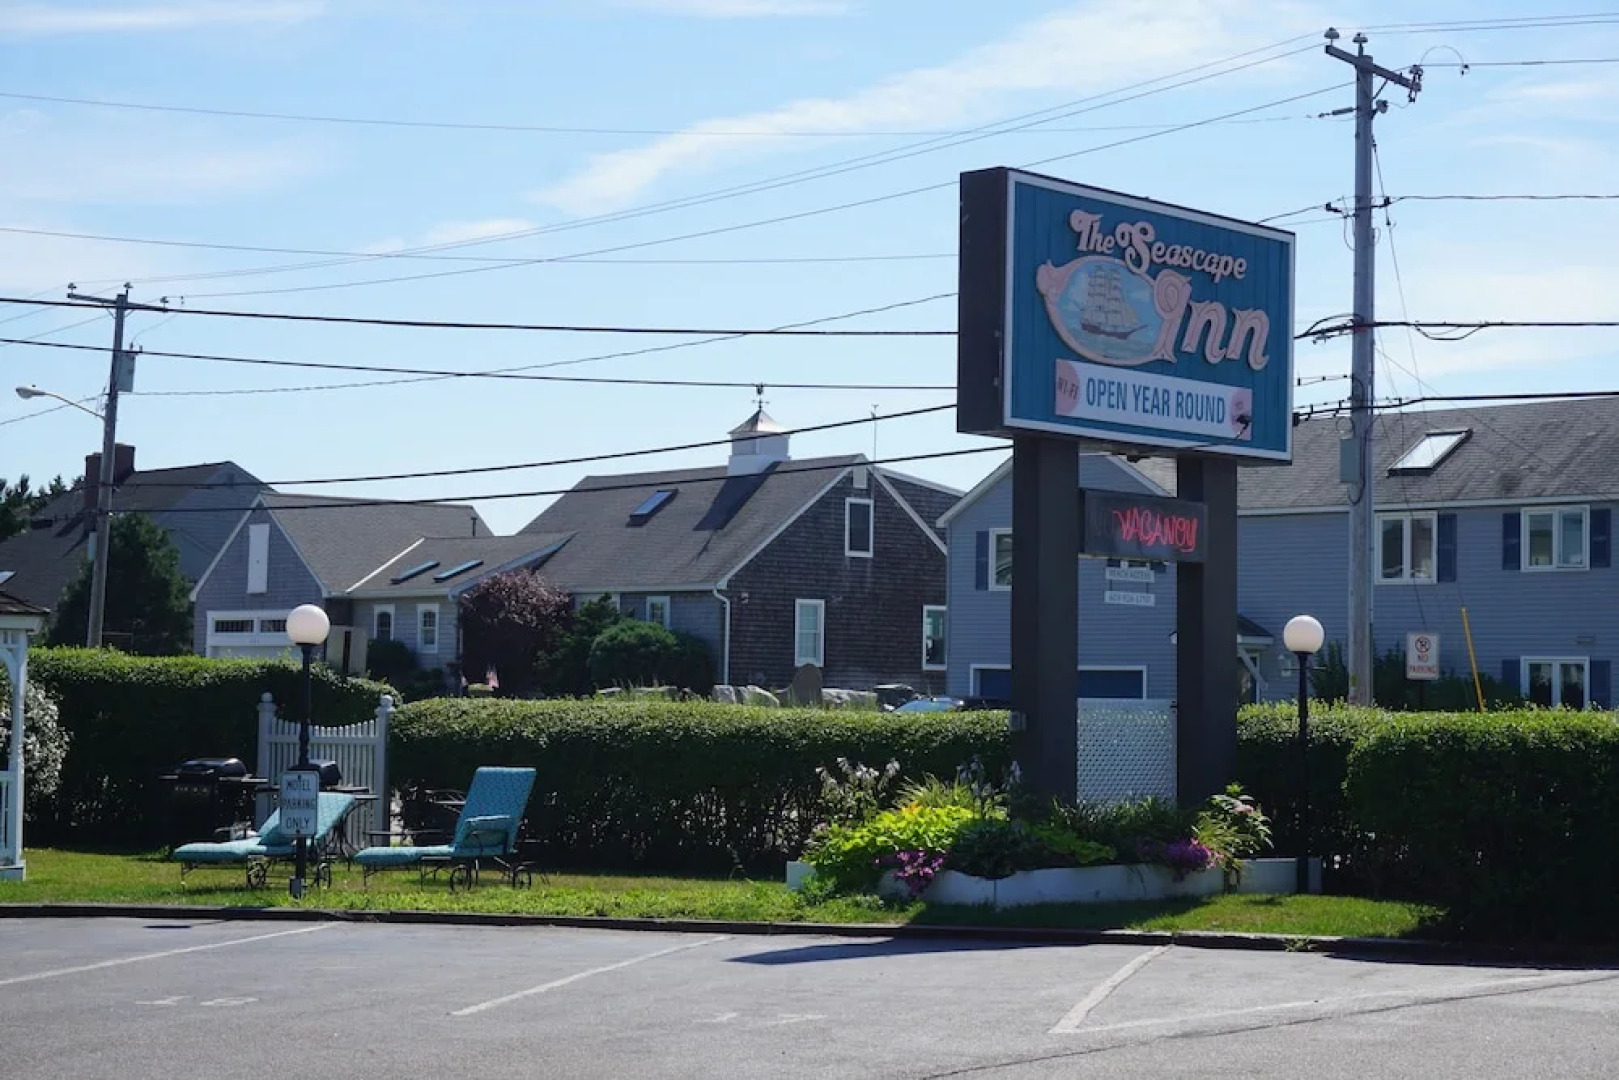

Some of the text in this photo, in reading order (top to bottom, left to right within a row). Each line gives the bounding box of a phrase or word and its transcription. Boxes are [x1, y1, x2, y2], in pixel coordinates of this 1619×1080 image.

[1070, 209, 1248, 283] The Seascape
[1153, 268, 1270, 370] Inn
[1086, 377, 1225, 425] OPEN YEAR ROUND
[1418, 653, 1428, 662] NO
[287, 779, 311, 790] MOTEL
[283, 798, 315, 809] PARKING
[286, 817, 310, 830] ONLY
